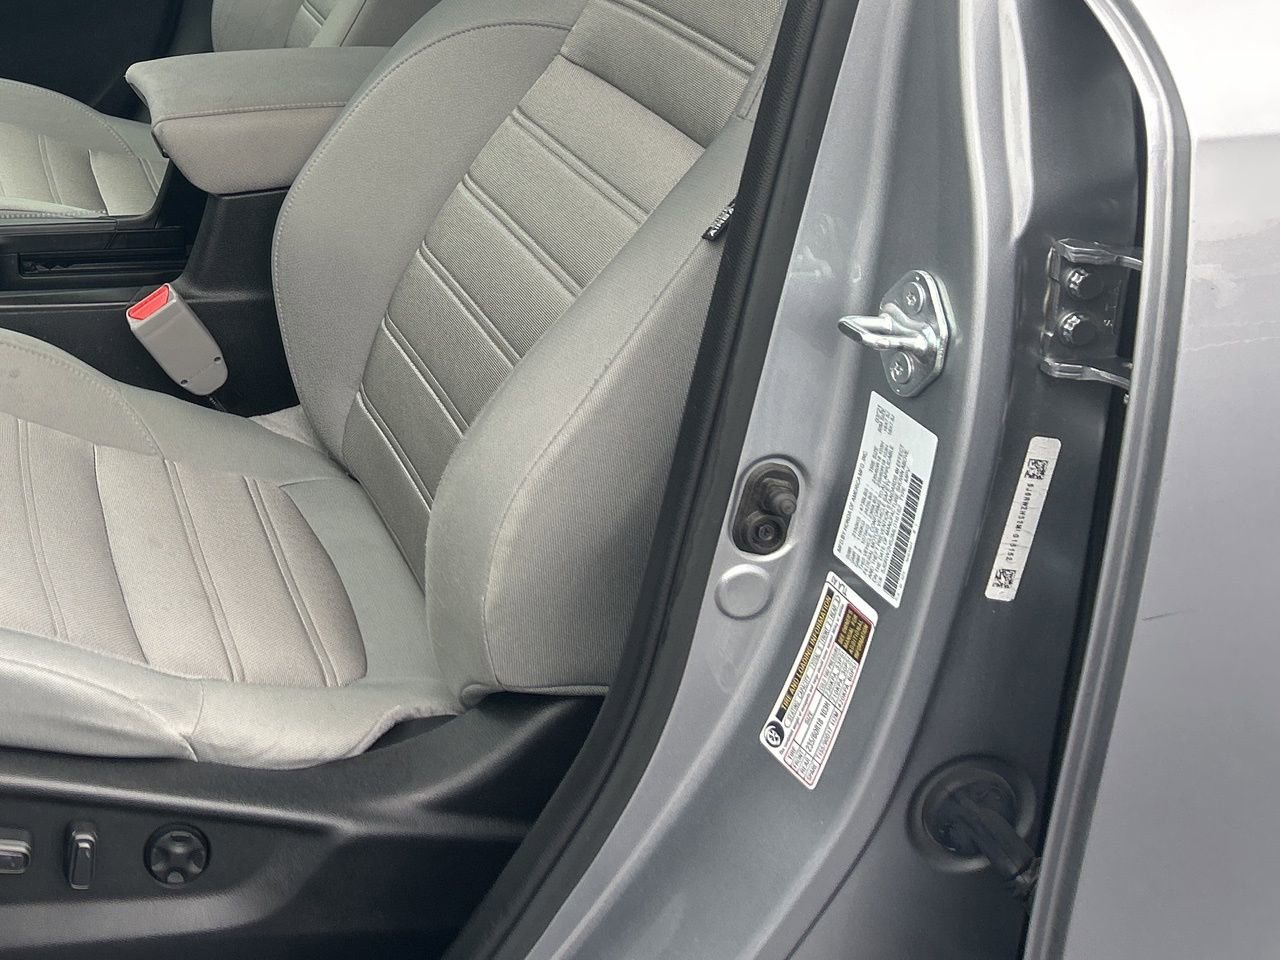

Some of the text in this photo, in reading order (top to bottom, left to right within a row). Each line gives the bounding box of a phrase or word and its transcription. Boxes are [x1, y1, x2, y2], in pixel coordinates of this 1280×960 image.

[780, 692, 792, 711] TIRE
[788, 676, 800, 696] AND
[795, 644, 813, 679] LOADING
[807, 594, 833, 647] INFORMATION
